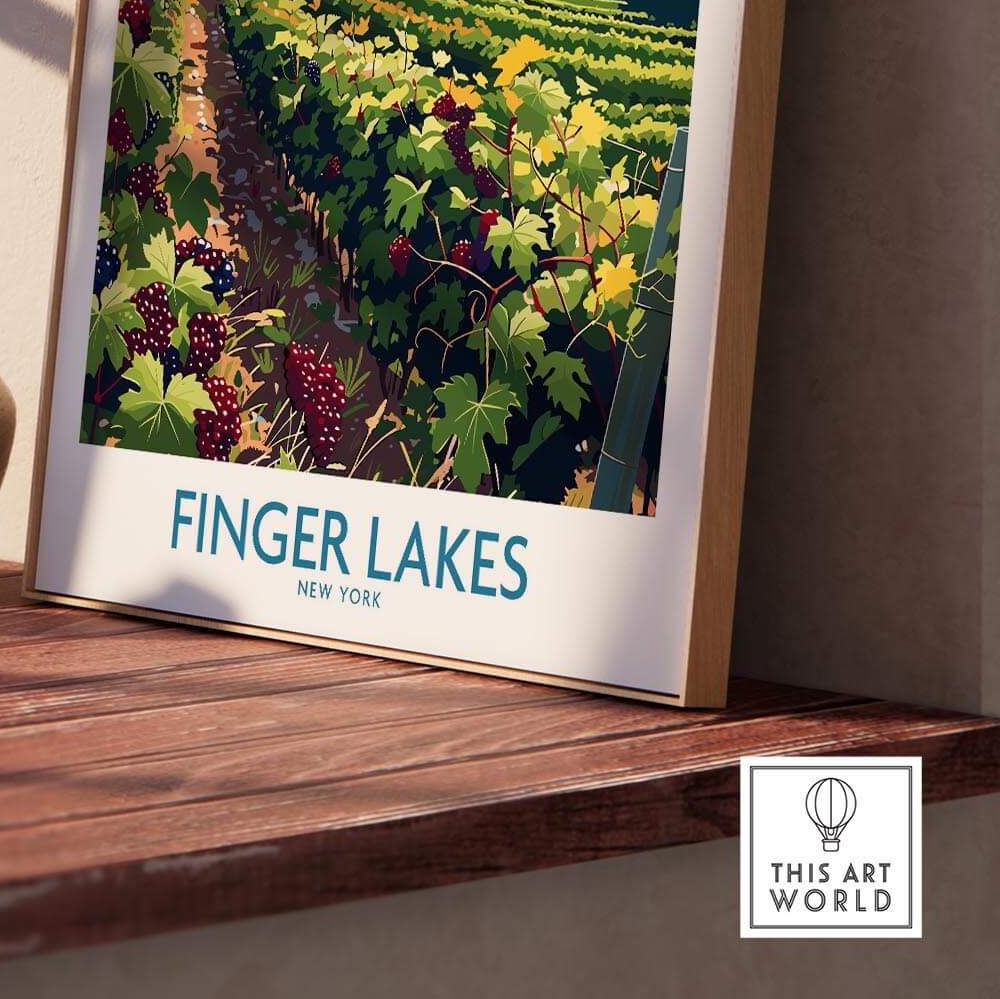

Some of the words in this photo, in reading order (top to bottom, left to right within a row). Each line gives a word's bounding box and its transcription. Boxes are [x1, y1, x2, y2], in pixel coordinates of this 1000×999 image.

[170, 488, 350, 575] FINGER
[366, 516, 529, 602] LAKES
[297, 579, 333, 602] NEW
[339, 586, 382, 609] YORK
